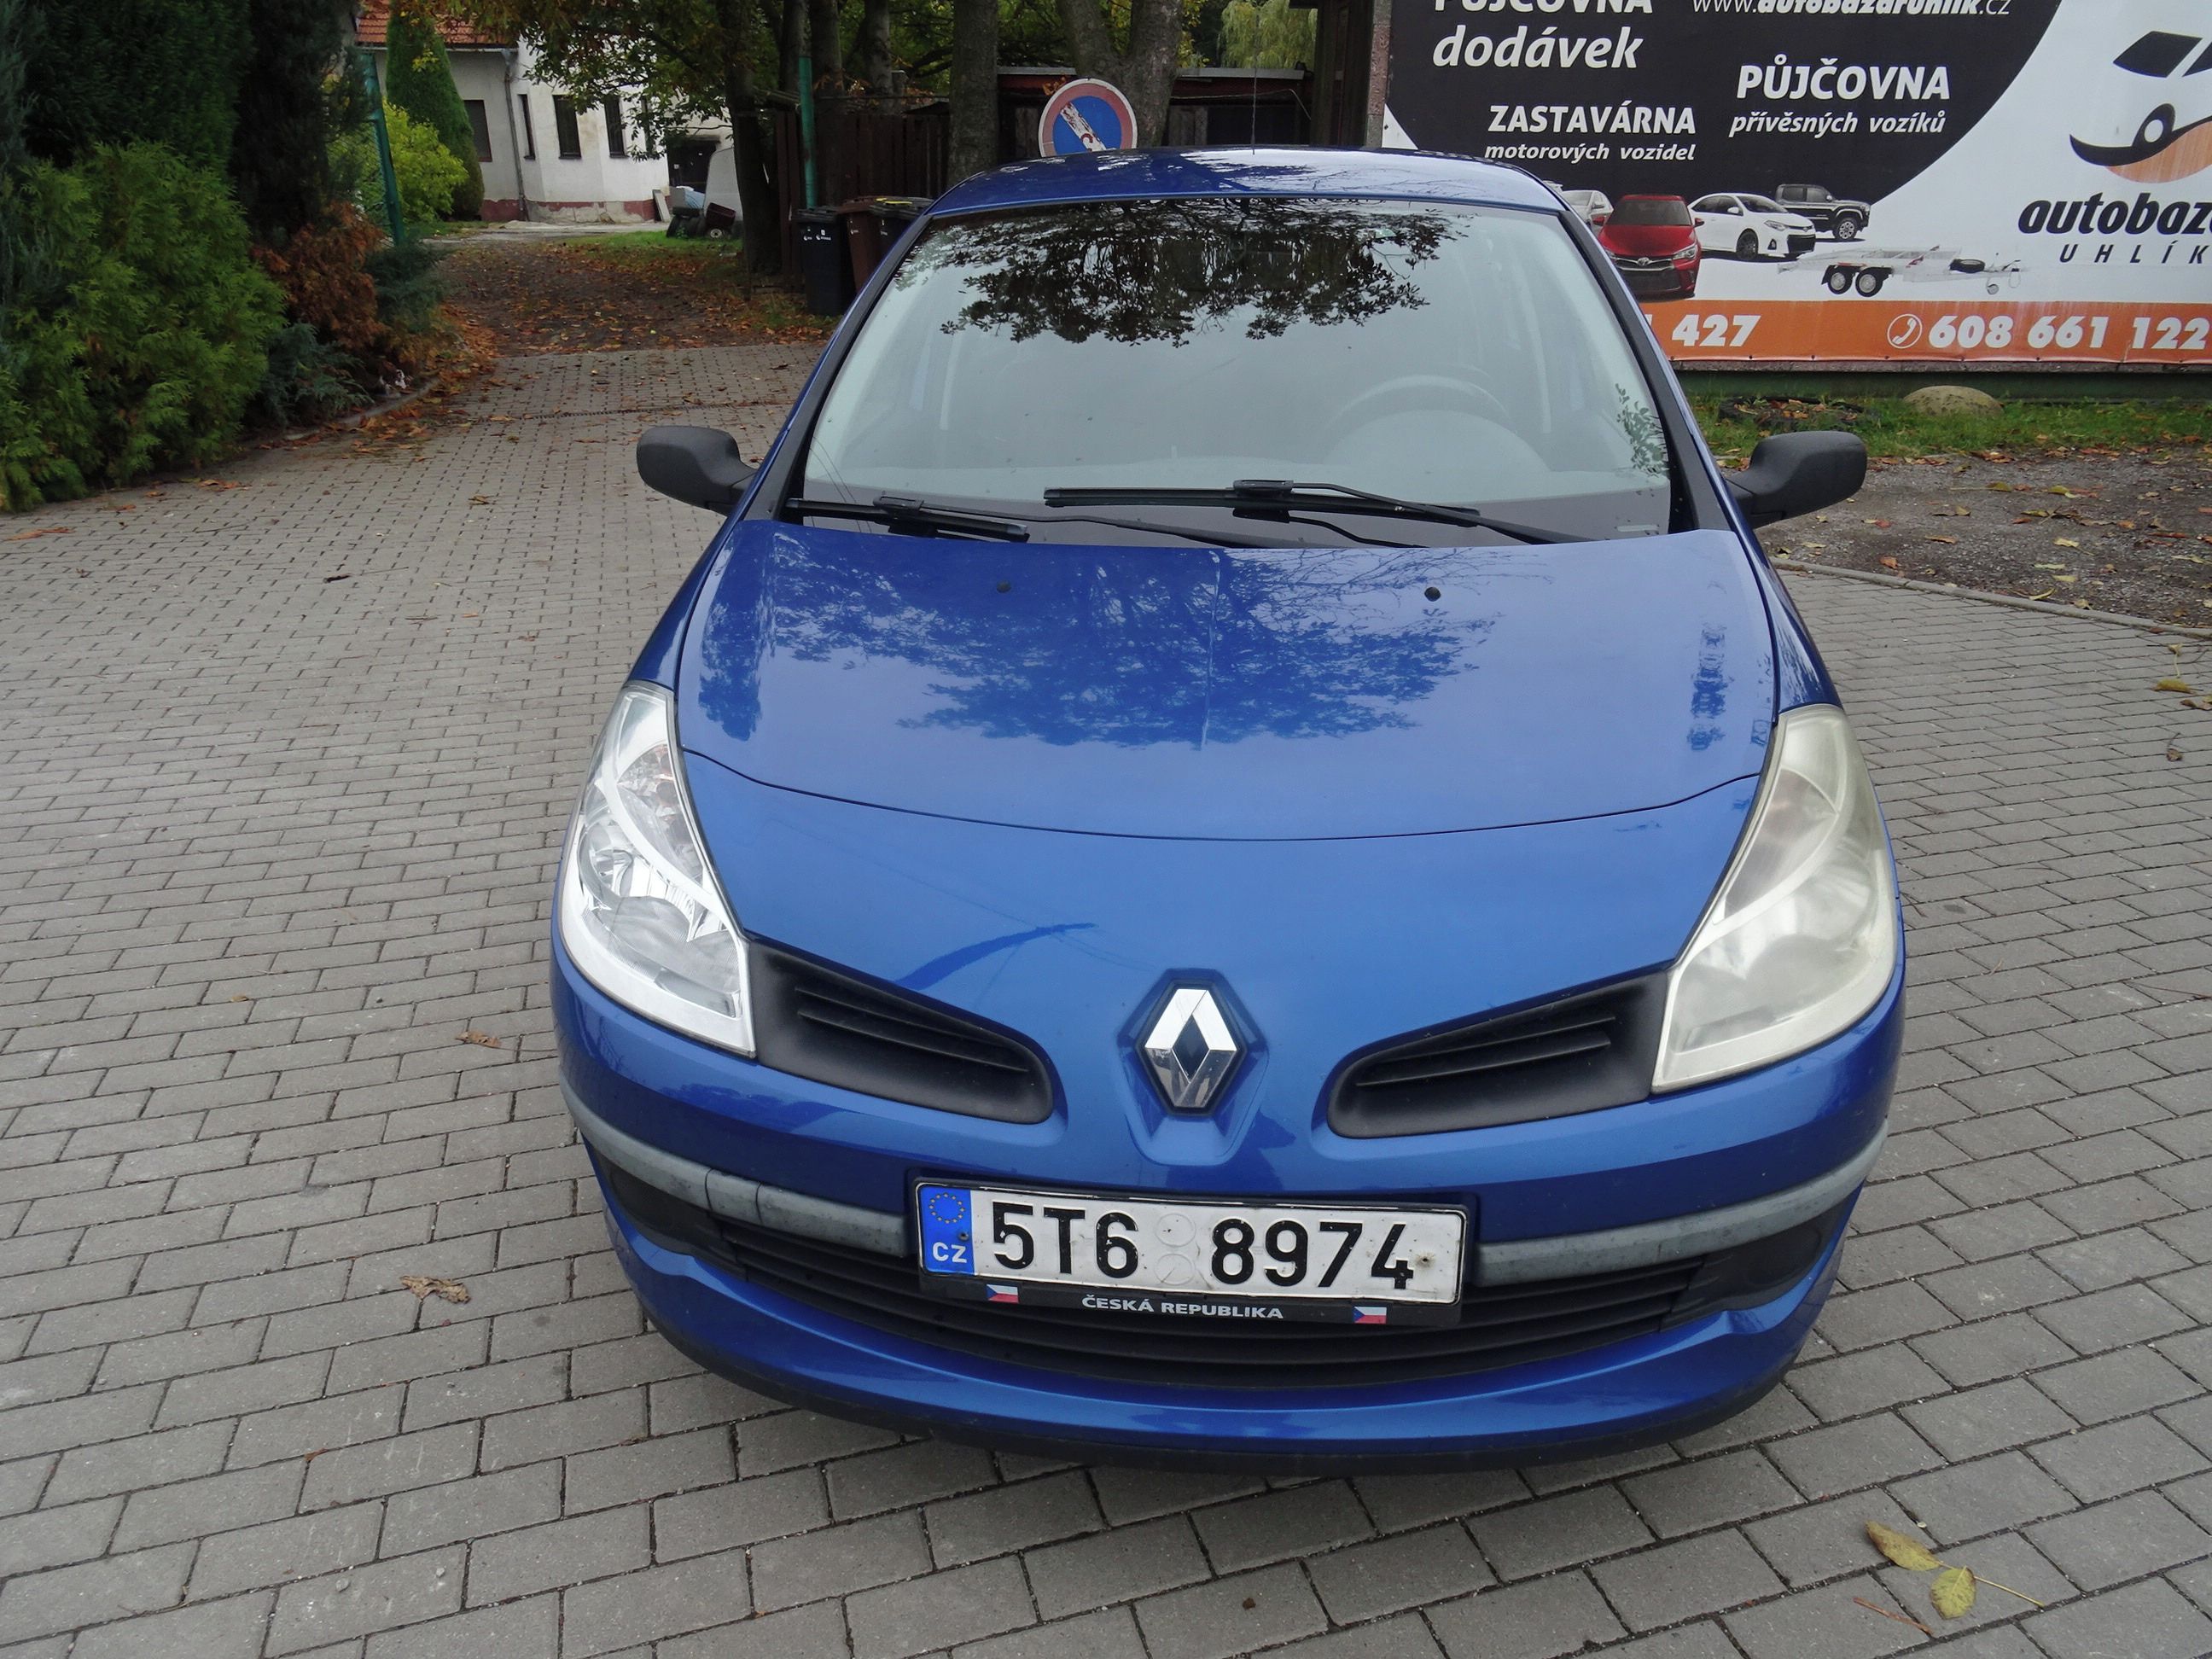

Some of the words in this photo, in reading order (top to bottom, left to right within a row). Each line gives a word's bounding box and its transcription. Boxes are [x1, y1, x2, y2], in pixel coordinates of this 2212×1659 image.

[1432, 24, 1644, 68] dodávek
[1736, 54, 1951, 100] PŮJČOVNA
[1487, 100, 1697, 134] ZASTAVÁRNA
[1728, 111, 1859, 139] přívěsných
[1869, 110, 1947, 133] vozíků
[1484, 143, 1610, 164] motorových
[1620, 144, 1697, 160] vozidel
[2017, 192, 2212, 236] autobaz
[1671, 314, 1762, 347] 427
[1928, 315, 2014, 349] 608
[2027, 315, 2110, 349] 661
[2132, 317, 2210, 350] 122
[932, 1242, 968, 1264] CZ
[992, 1201, 1139, 1278] 5T6
[1211, 1218, 1415, 1290] 8974
[1081, 1294, 1155, 1313] ČESKÁ
[1161, 1301, 1284, 1319] REPUBLIKA
